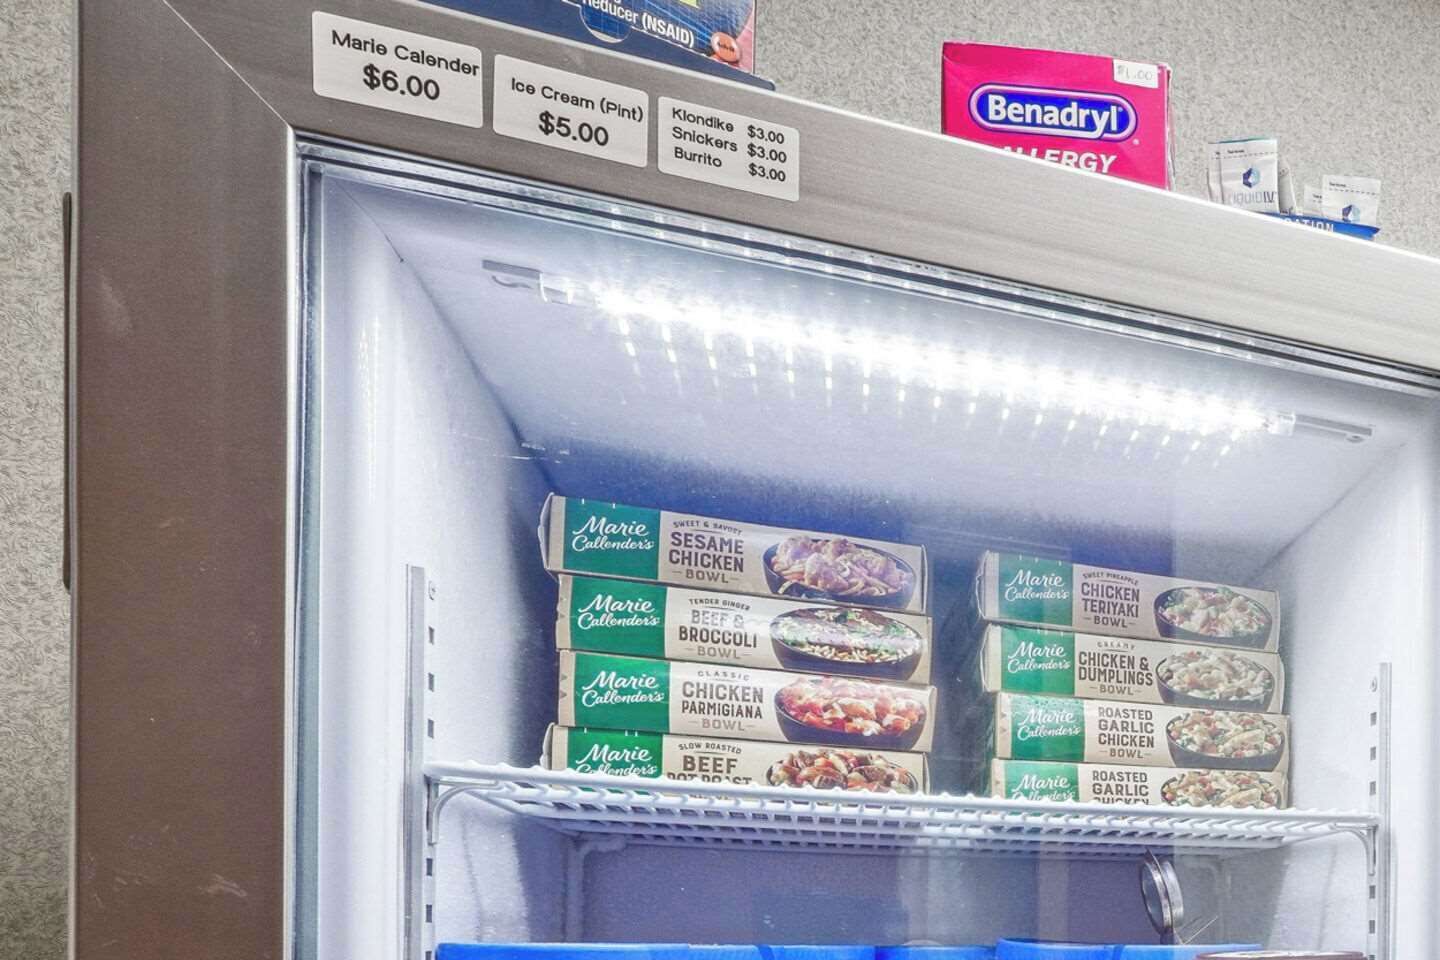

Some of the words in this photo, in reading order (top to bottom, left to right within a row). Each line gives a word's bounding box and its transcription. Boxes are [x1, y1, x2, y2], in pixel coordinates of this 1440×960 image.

[641, 13, 694, 48] (NSAID)
[331, 29, 388, 57] Marie
[394, 43, 481, 77] Calender
[362, 63, 440, 101] $6.00
[510, 77, 537, 96] Ice
[540, 84, 595, 110] Cream
[599, 97, 645, 124] (Pint)
[671, 107, 735, 133] Klondike
[746, 124, 786, 145] $3.00
[987, 93, 1119, 140] Benadryl
[538, 110, 610, 148] $5.00
[671, 127, 738, 153] Snickers
[746, 143, 787, 163] $3.00
[674, 146, 723, 169] Burrito
[748, 163, 787, 183] $3.00
[572, 515, 649, 536] Marie
[571, 533, 655, 553] Callender's
[671, 532, 744, 555] SESAME
[668, 549, 744, 573] CHICKEN
[684, 568, 730, 584] BOWL
[1005, 569, 1065, 587] Marie
[1004, 584, 1070, 601] Callender's
[1081, 582, 1140, 602] CHICKEN
[577, 594, 654, 615] Marie
[1081, 598, 1139, 618] TERIYAKI
[577, 611, 660, 630] Callender's
[690, 609, 730, 627] BEEF
[733, 614, 745, 628] &
[1093, 615, 1128, 629] BOWL
[678, 626, 758, 647] BROCCOLI
[696, 644, 742, 660] BOWL
[1008, 640, 1065, 658] Marie
[1007, 656, 1072, 674] Callender's
[1078, 651, 1135, 670] CHICKEN
[1139, 656, 1150, 671] &
[582, 671, 658, 691] Marie
[1078, 668, 1154, 687] DUMPLINGS
[581, 687, 665, 707] Callender's
[681, 681, 764, 704] CHICKEN
[1099, 683, 1134, 696] BOWL
[681, 700, 763, 719] PARMIGIANA
[1018, 707, 1076, 724] Marie
[1098, 707, 1154, 721] ROASTED
[701, 717, 746, 732] BOWL
[1017, 723, 1081, 740] Callender's
[1098, 719, 1155, 734] GARLIC
[1098, 733, 1155, 748] CHICKEN
[1109, 748, 1145, 759] BOWL
[683, 756, 738, 774] BEEF
[1012, 774, 1071, 791] Marie
[1092, 771, 1149, 783] ROASTED
[1092, 783, 1149, 797] GARLIC
